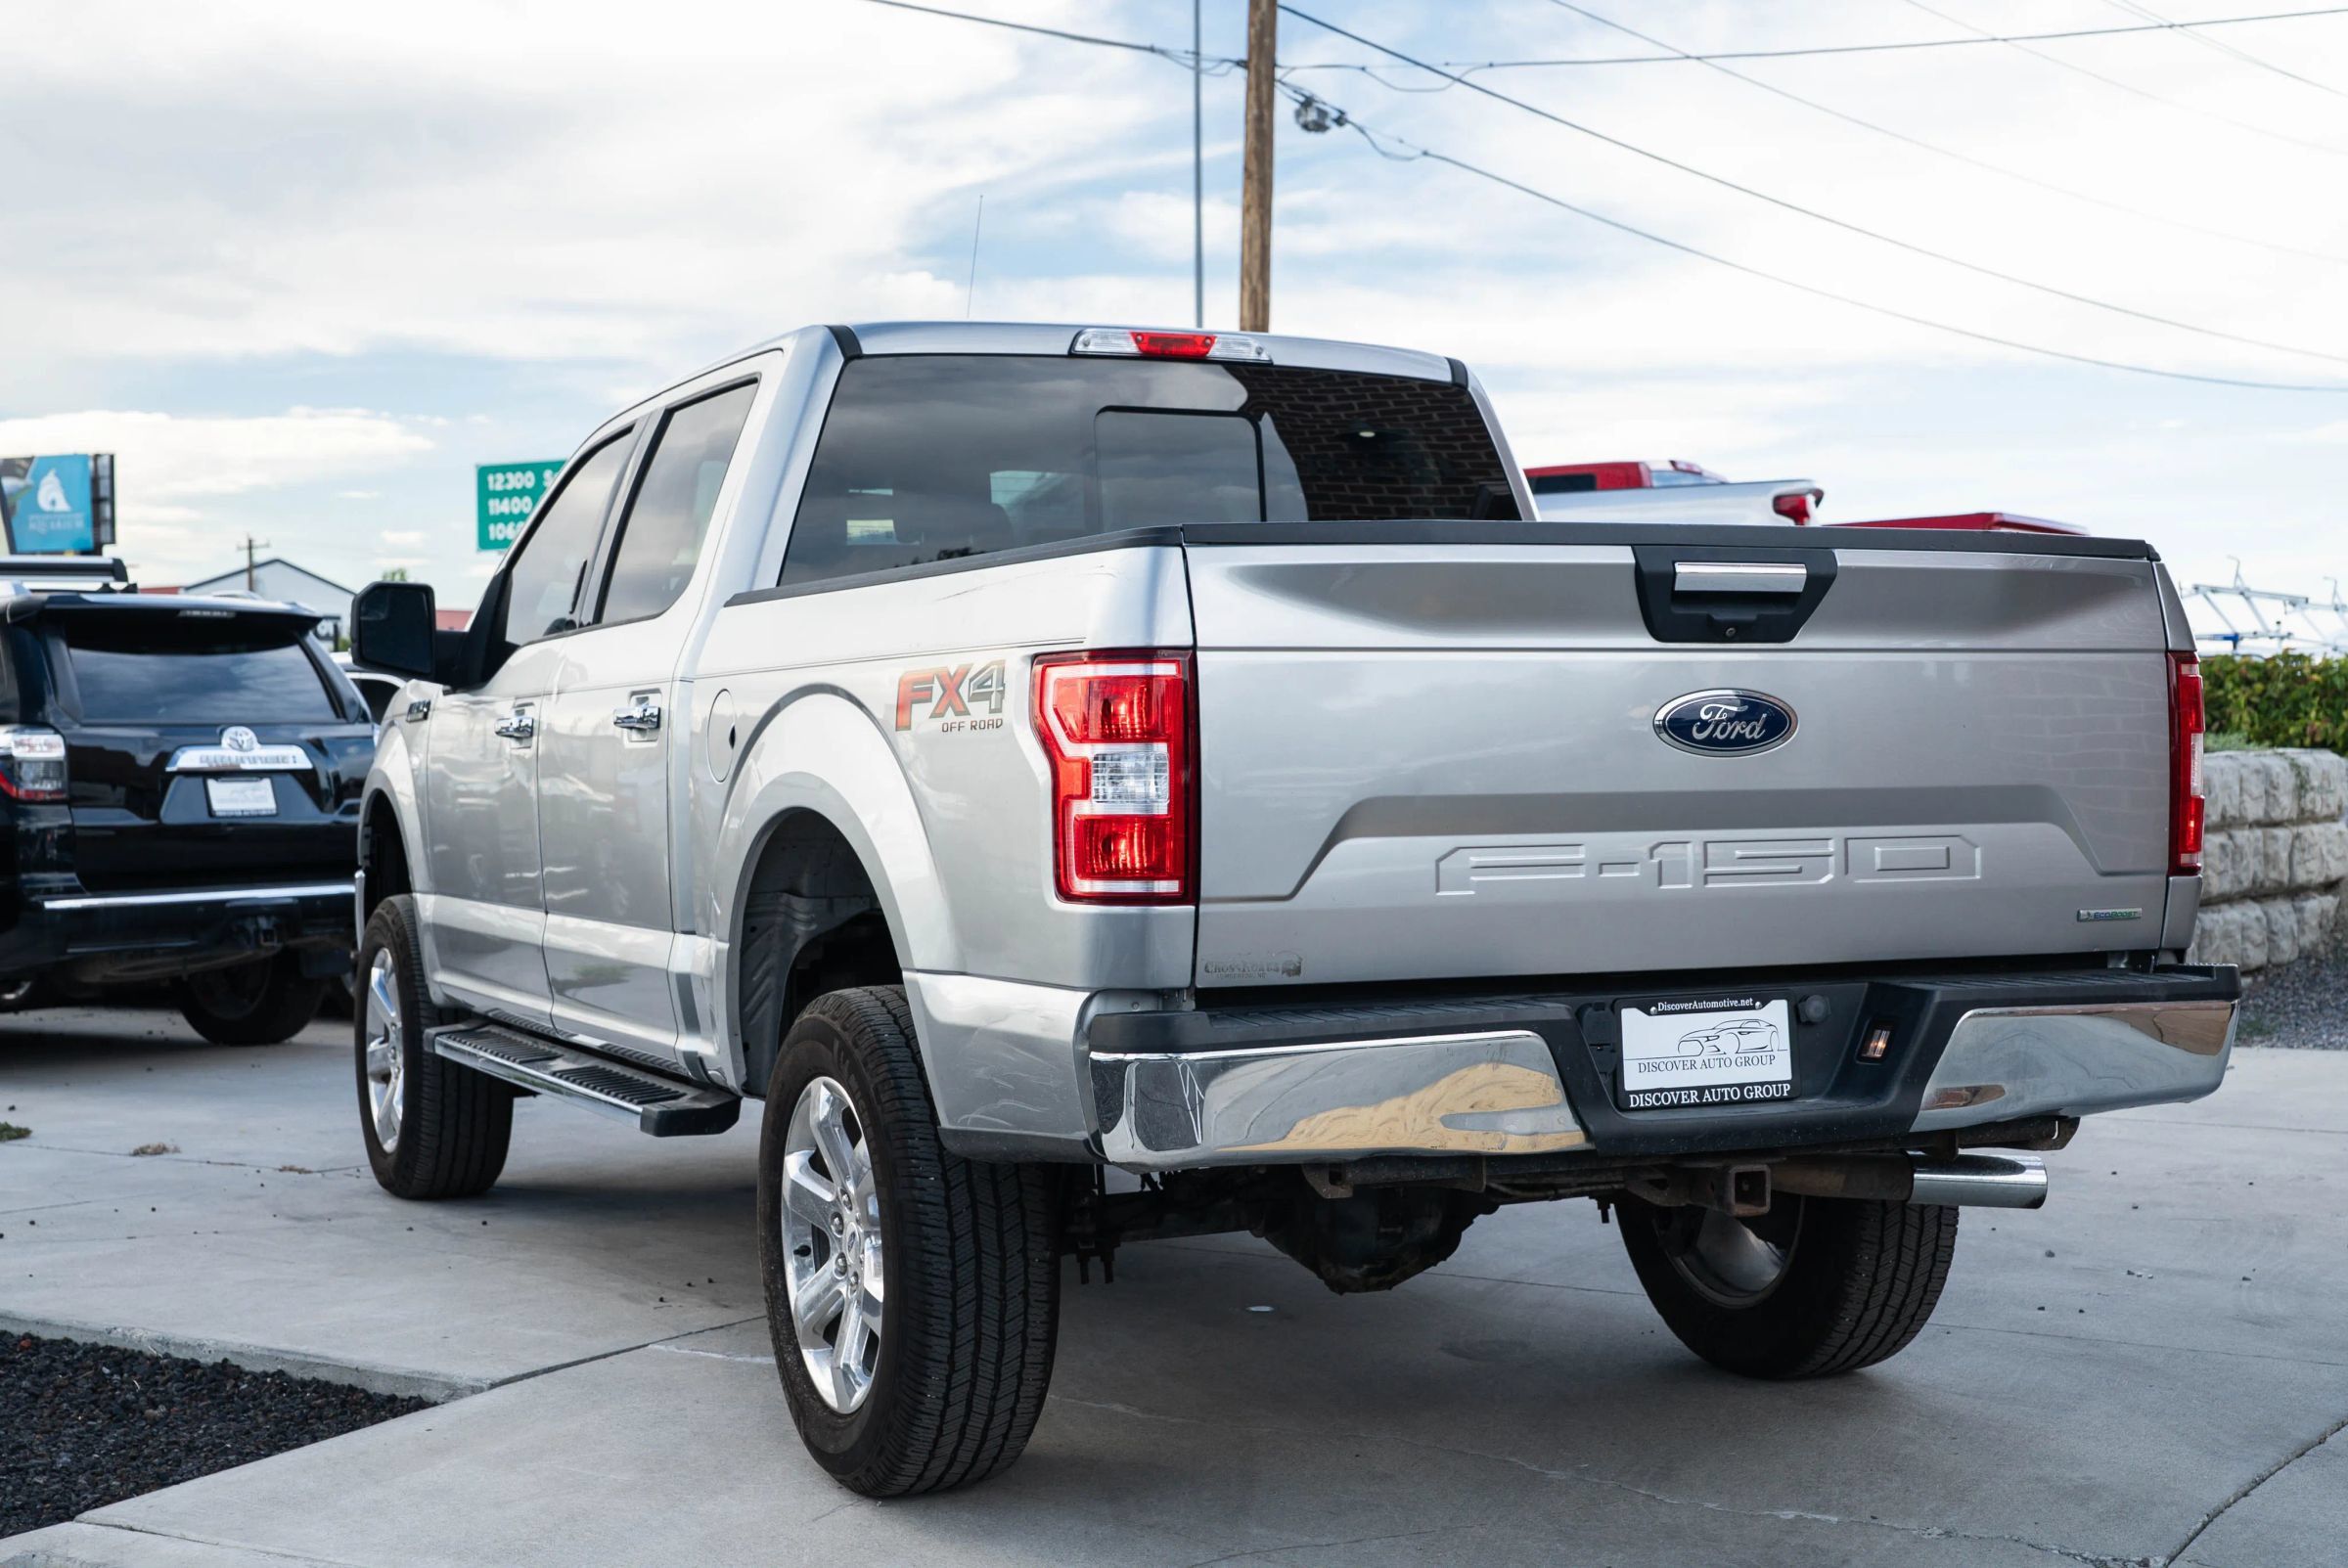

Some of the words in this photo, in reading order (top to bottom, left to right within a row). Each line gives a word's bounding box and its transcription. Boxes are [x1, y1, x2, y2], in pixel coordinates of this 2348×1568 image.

[487, 470, 535, 491] 12300
[488, 496, 532, 515] 11400
[895, 659, 1006, 732] FX4
[941, 722, 966, 733] OFF
[970, 718, 1003, 731] ROAD
[1692, 703, 1767, 740] Ford
[1435, 835, 1980, 895] F-150
[1657, 998, 1753, 1011] DiscoverAutomotive.net
[1638, 1058, 1697, 1073] DISCOVER
[1700, 1056, 1732, 1069] AUTO
[1735, 1054, 1776, 1067] GROUP
[1629, 1090, 1700, 1108] DISCOVER
[1702, 1087, 1740, 1101] AUTO
[1743, 1083, 1791, 1098] GROUP
